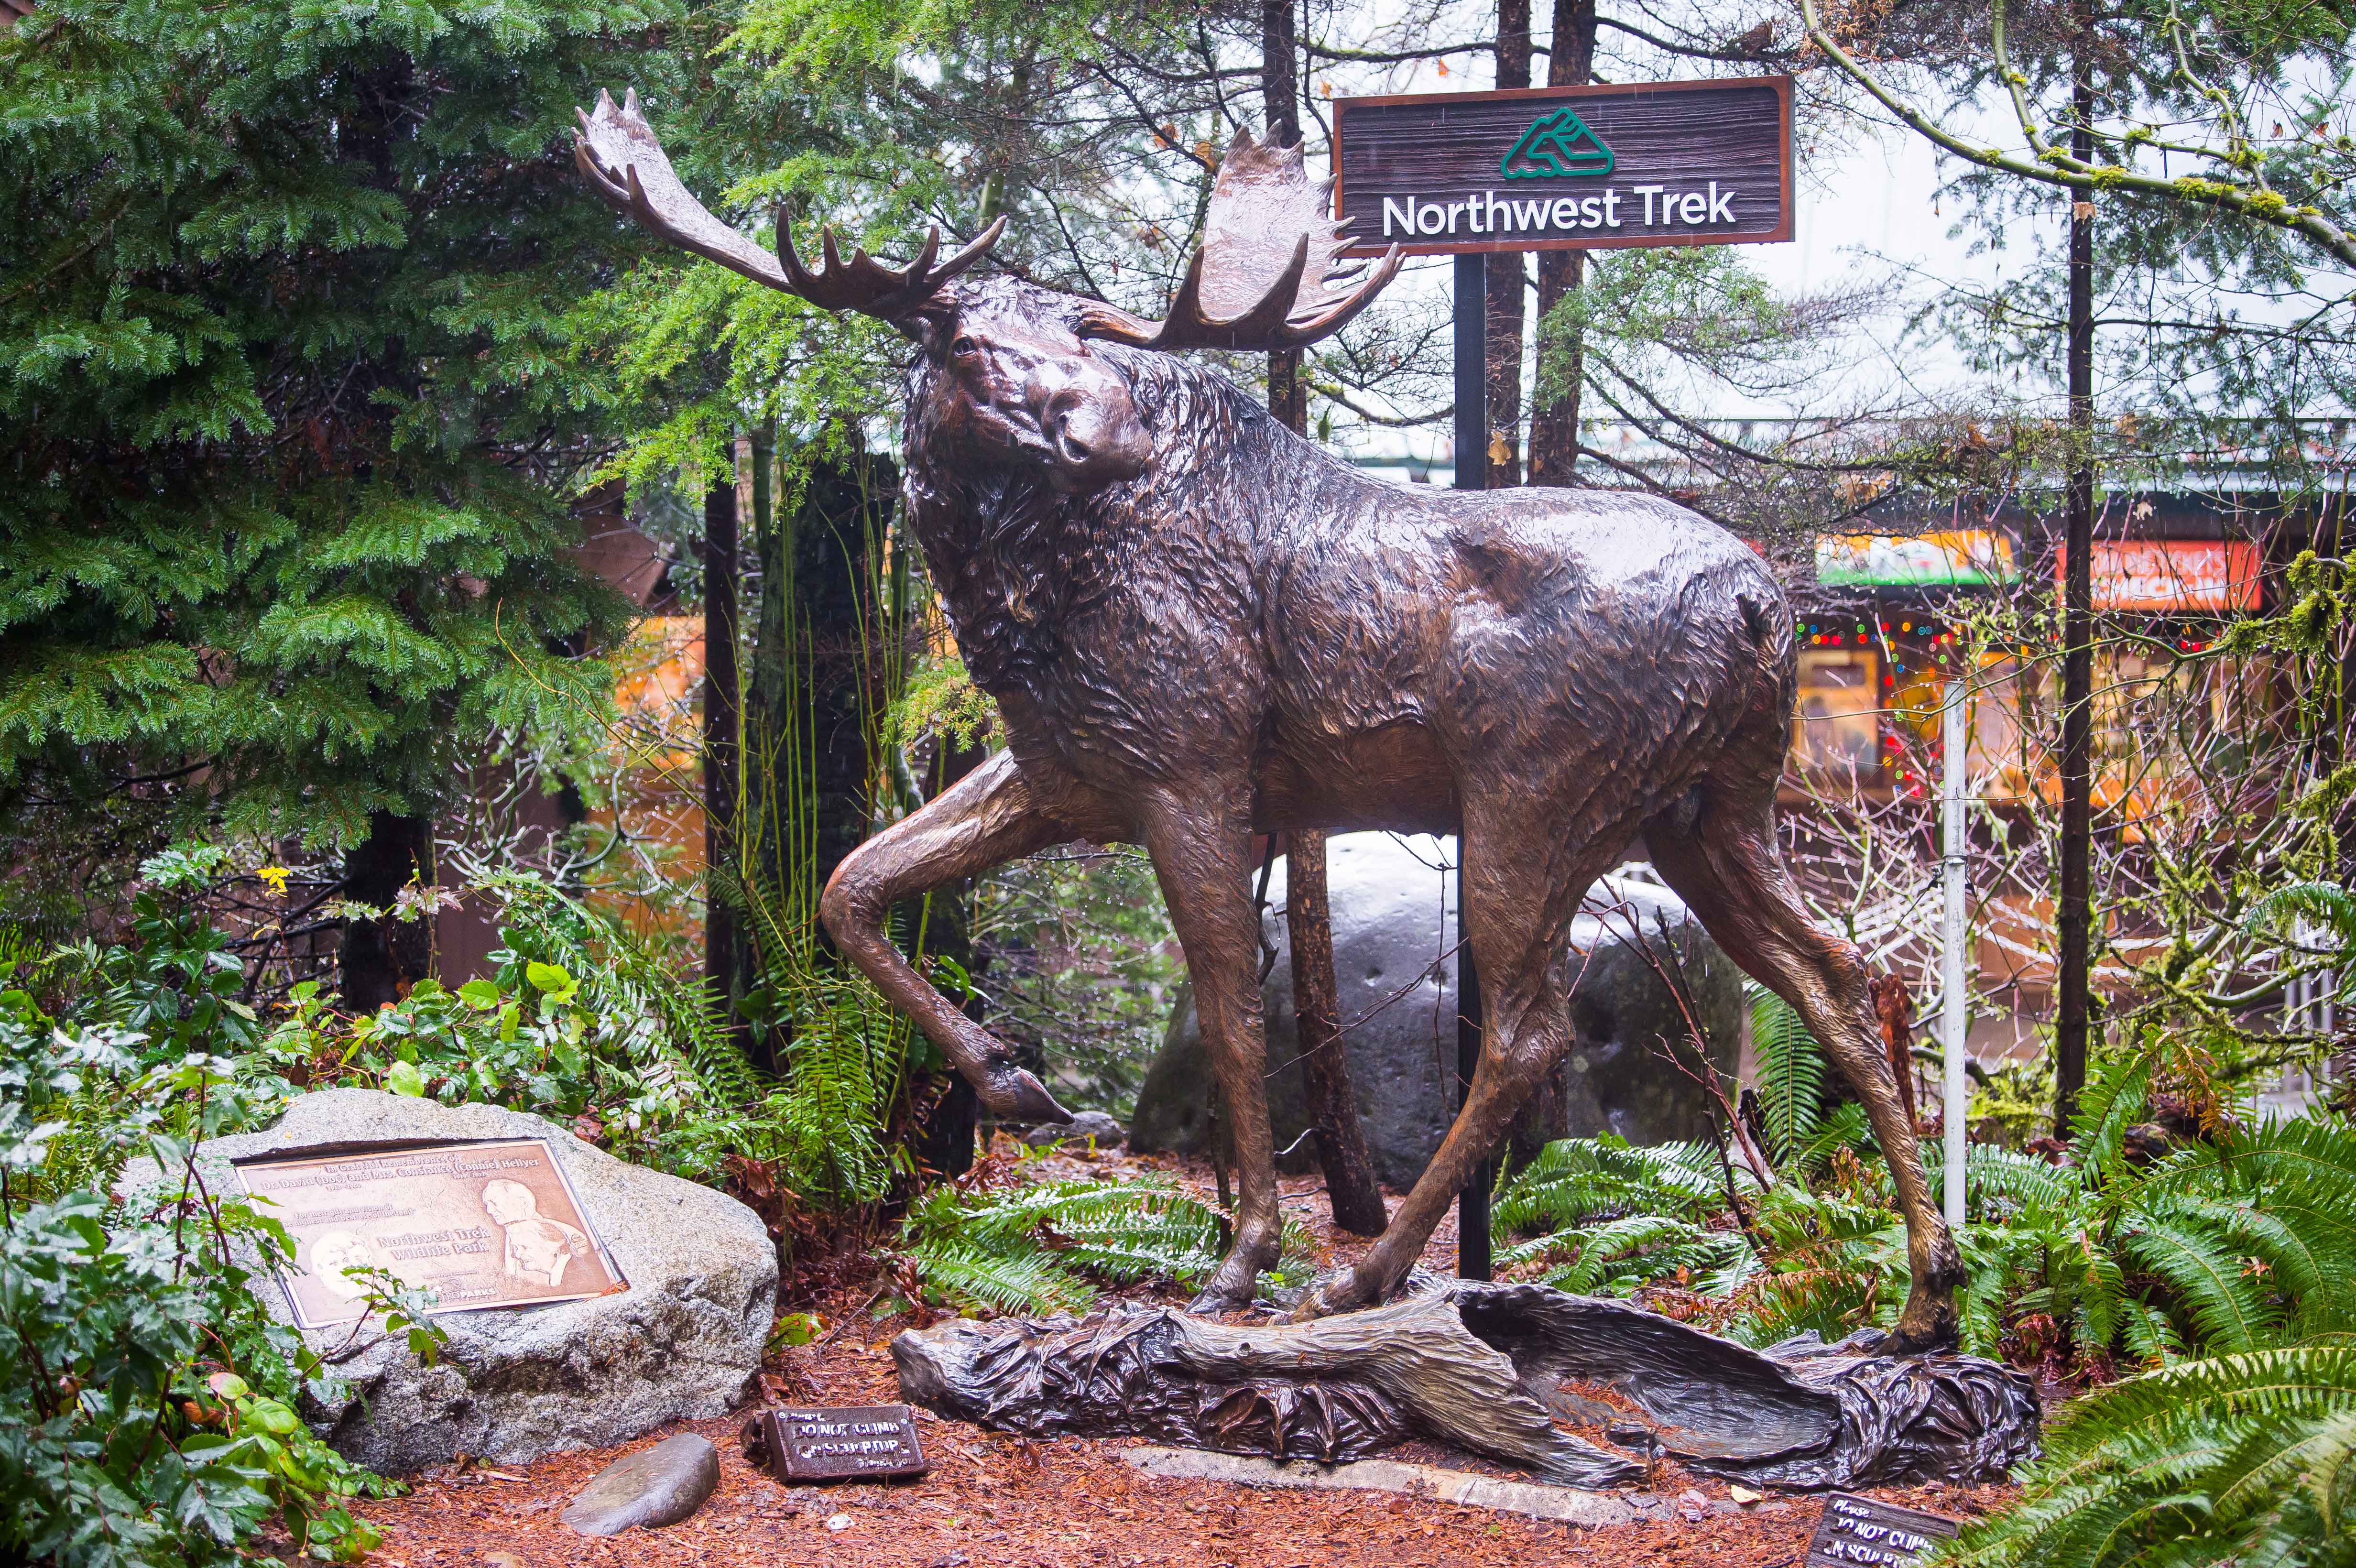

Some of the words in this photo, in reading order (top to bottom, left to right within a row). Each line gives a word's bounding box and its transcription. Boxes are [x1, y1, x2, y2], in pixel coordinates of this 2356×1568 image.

[1383, 188, 1621, 236] Northwest
[1633, 181, 1736, 226] Trek
[262, 1181, 278, 1190] Dr.
[281, 1176, 314, 1189] David
[315, 1175, 346, 1186] (Doc)
[348, 1173, 370, 1182] and
[371, 1170, 397, 1180] Mrs.
[398, 1165, 453, 1177] Constance
[455, 1159, 500, 1172] (Connie)
[501, 1158, 540, 1169] Hellyer
[338, 1160, 380, 1172] Grateful
[382, 1156, 447, 1168] Remembrance
[378, 1231, 455, 1248] Northwest
[455, 1226, 491, 1240] Trek
[392, 1244, 452, 1261] Wildlife
[453, 1241, 489, 1254] Park
[820, 1423, 850, 1437] NOT
[854, 1422, 900, 1436] CLIMB
[1854, 1522, 1888, 1541] NOT
